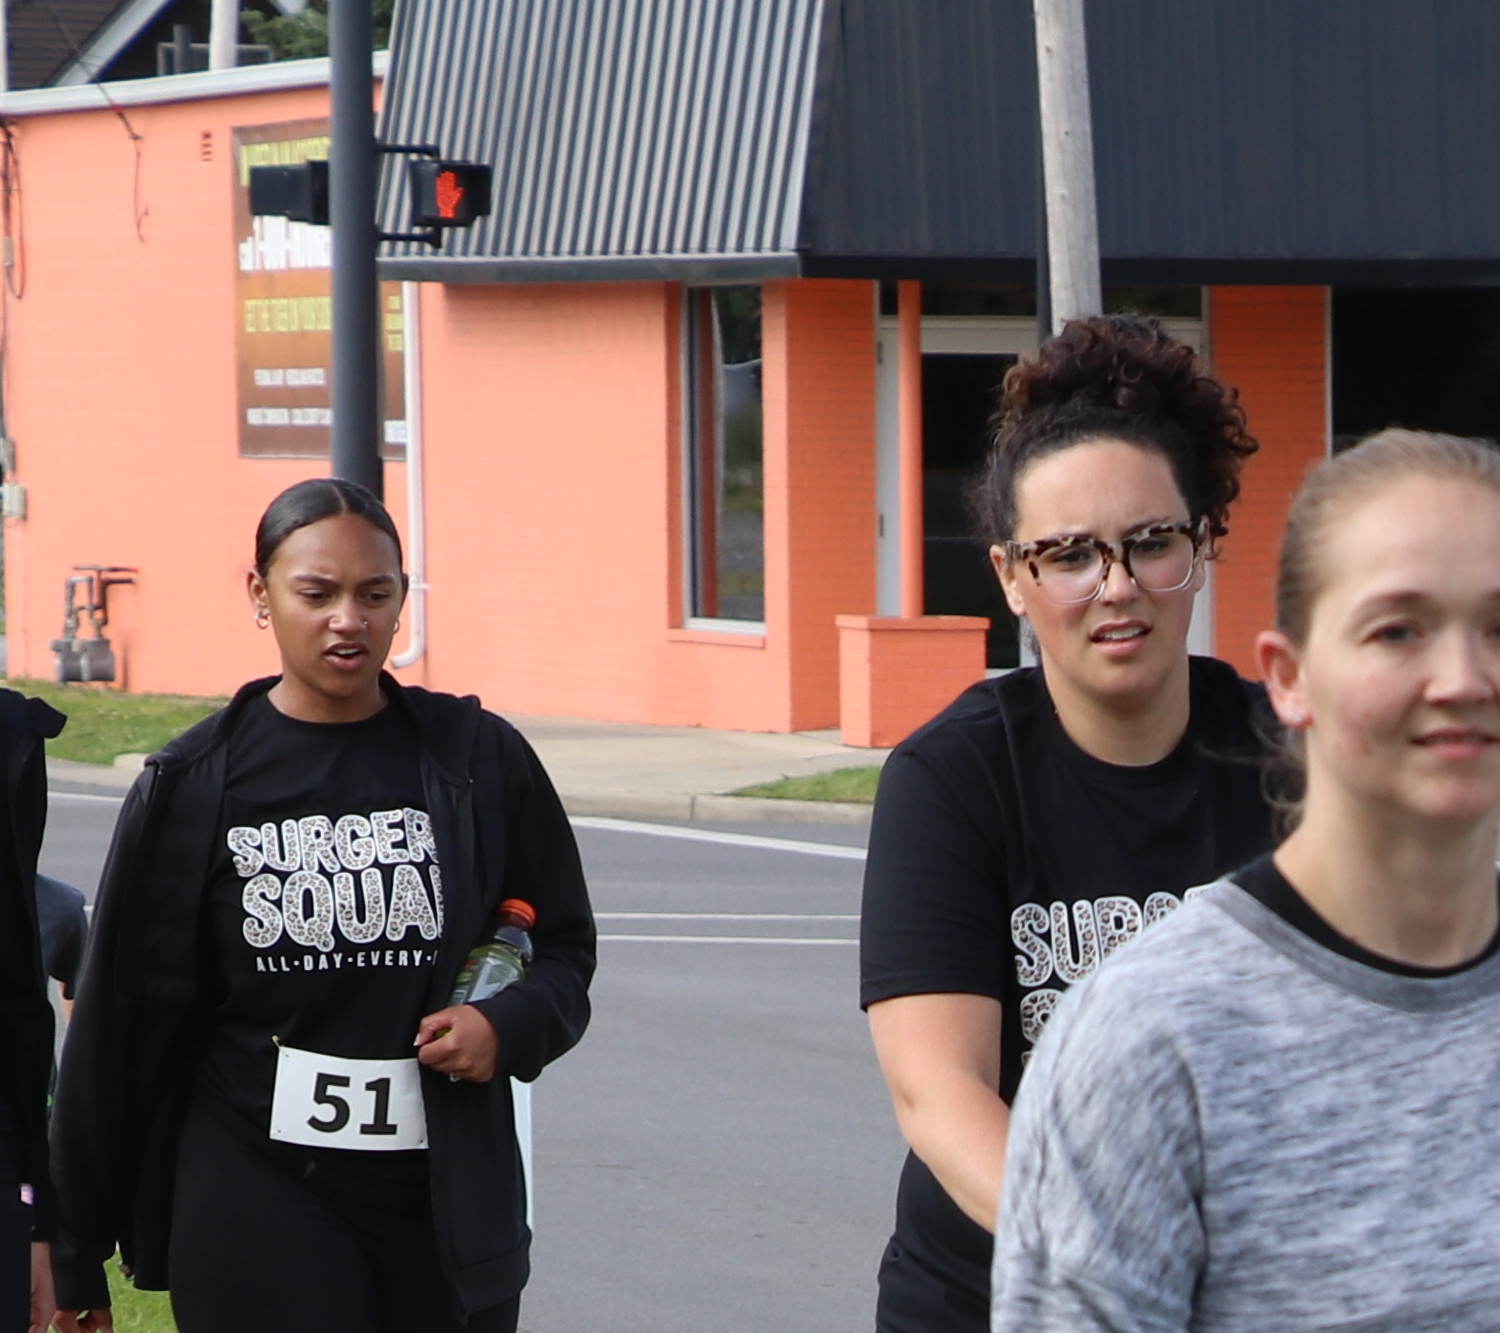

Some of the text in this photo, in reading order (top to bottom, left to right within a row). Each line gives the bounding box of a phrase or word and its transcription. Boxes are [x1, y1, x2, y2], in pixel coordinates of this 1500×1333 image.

[227, 807, 440, 877] SURGER
[242, 864, 444, 953] SQUA
[306, 1073, 398, 1136] 51
